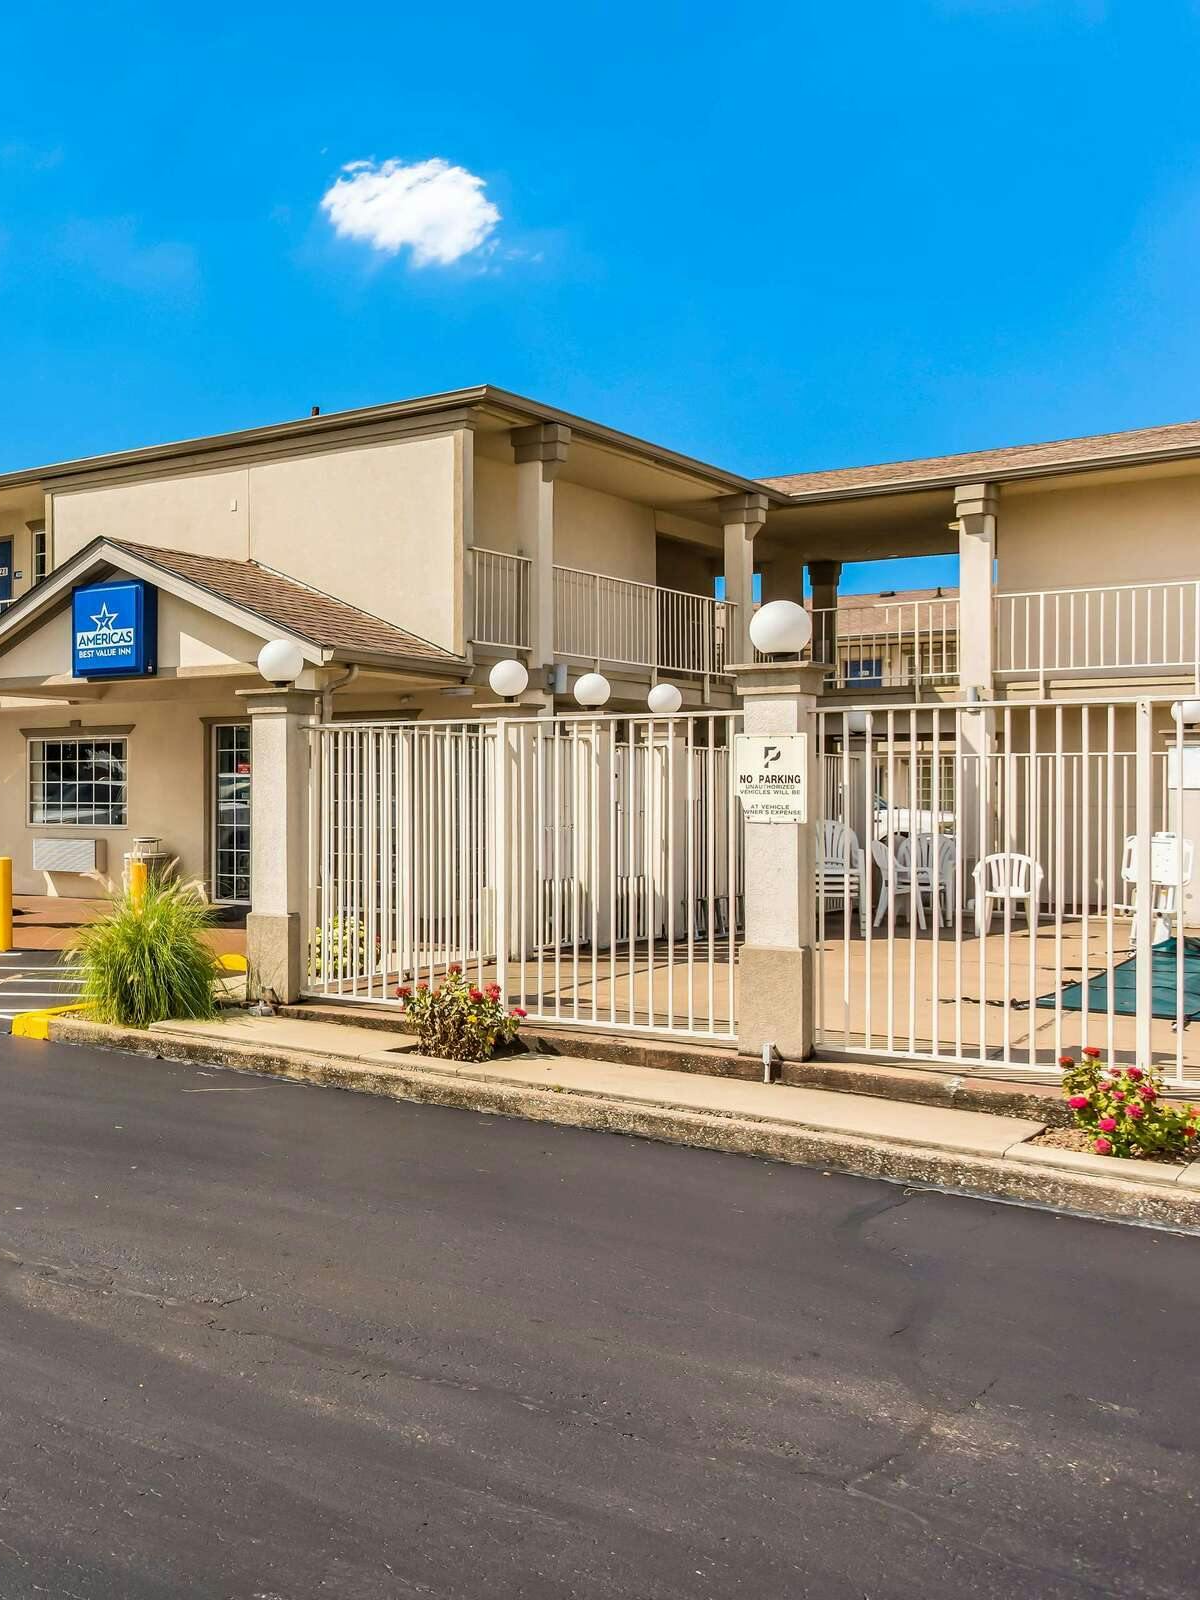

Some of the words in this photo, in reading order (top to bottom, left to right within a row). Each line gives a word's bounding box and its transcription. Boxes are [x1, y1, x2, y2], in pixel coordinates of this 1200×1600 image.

[78, 631, 132, 647] AMERICAS
[79, 650, 94, 659] BEST
[96, 648, 117, 657] VALUE
[118, 647, 131, 655] INN
[739, 775, 753, 784] NO
[759, 775, 801, 784] PARKING
